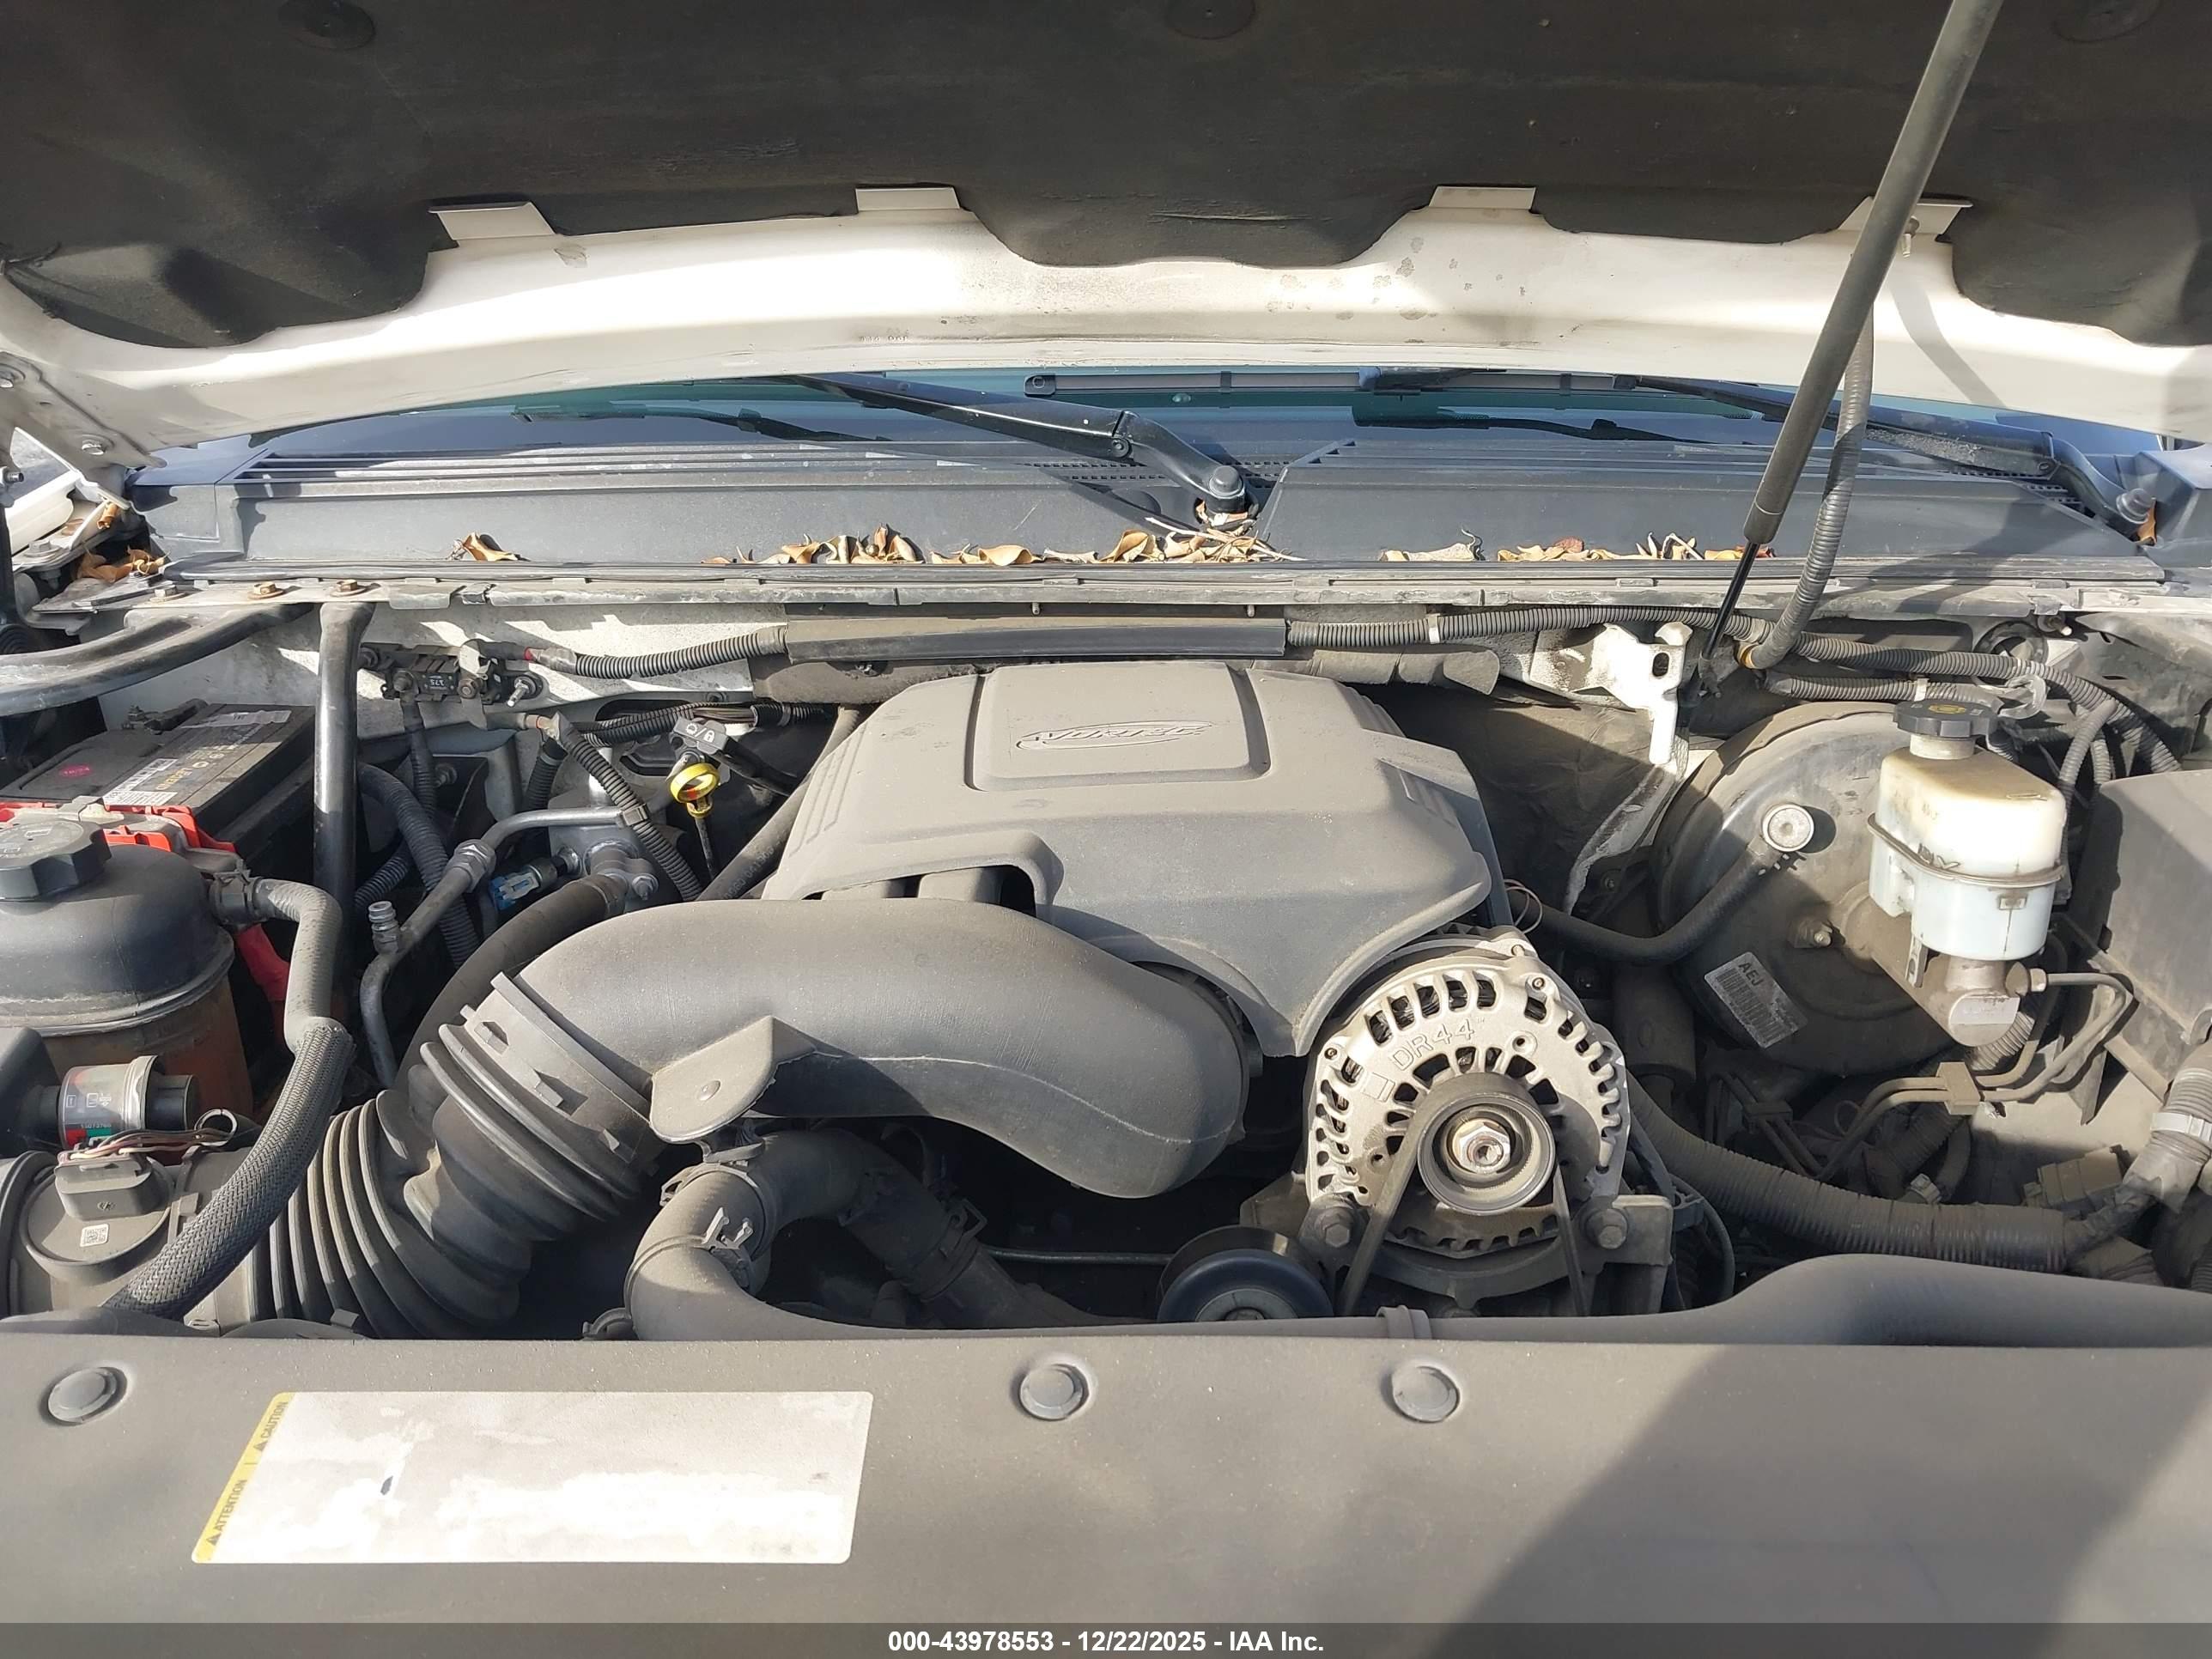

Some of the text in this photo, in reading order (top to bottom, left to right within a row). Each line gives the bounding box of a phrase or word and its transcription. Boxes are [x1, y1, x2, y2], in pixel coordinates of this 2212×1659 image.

[1739, 963, 1765, 986] AEJ
[1390, 1018, 1475, 1072] DR44
[260, 1401, 289, 1438] CAUTION
[213, 1479, 248, 1532] ATTENTION
